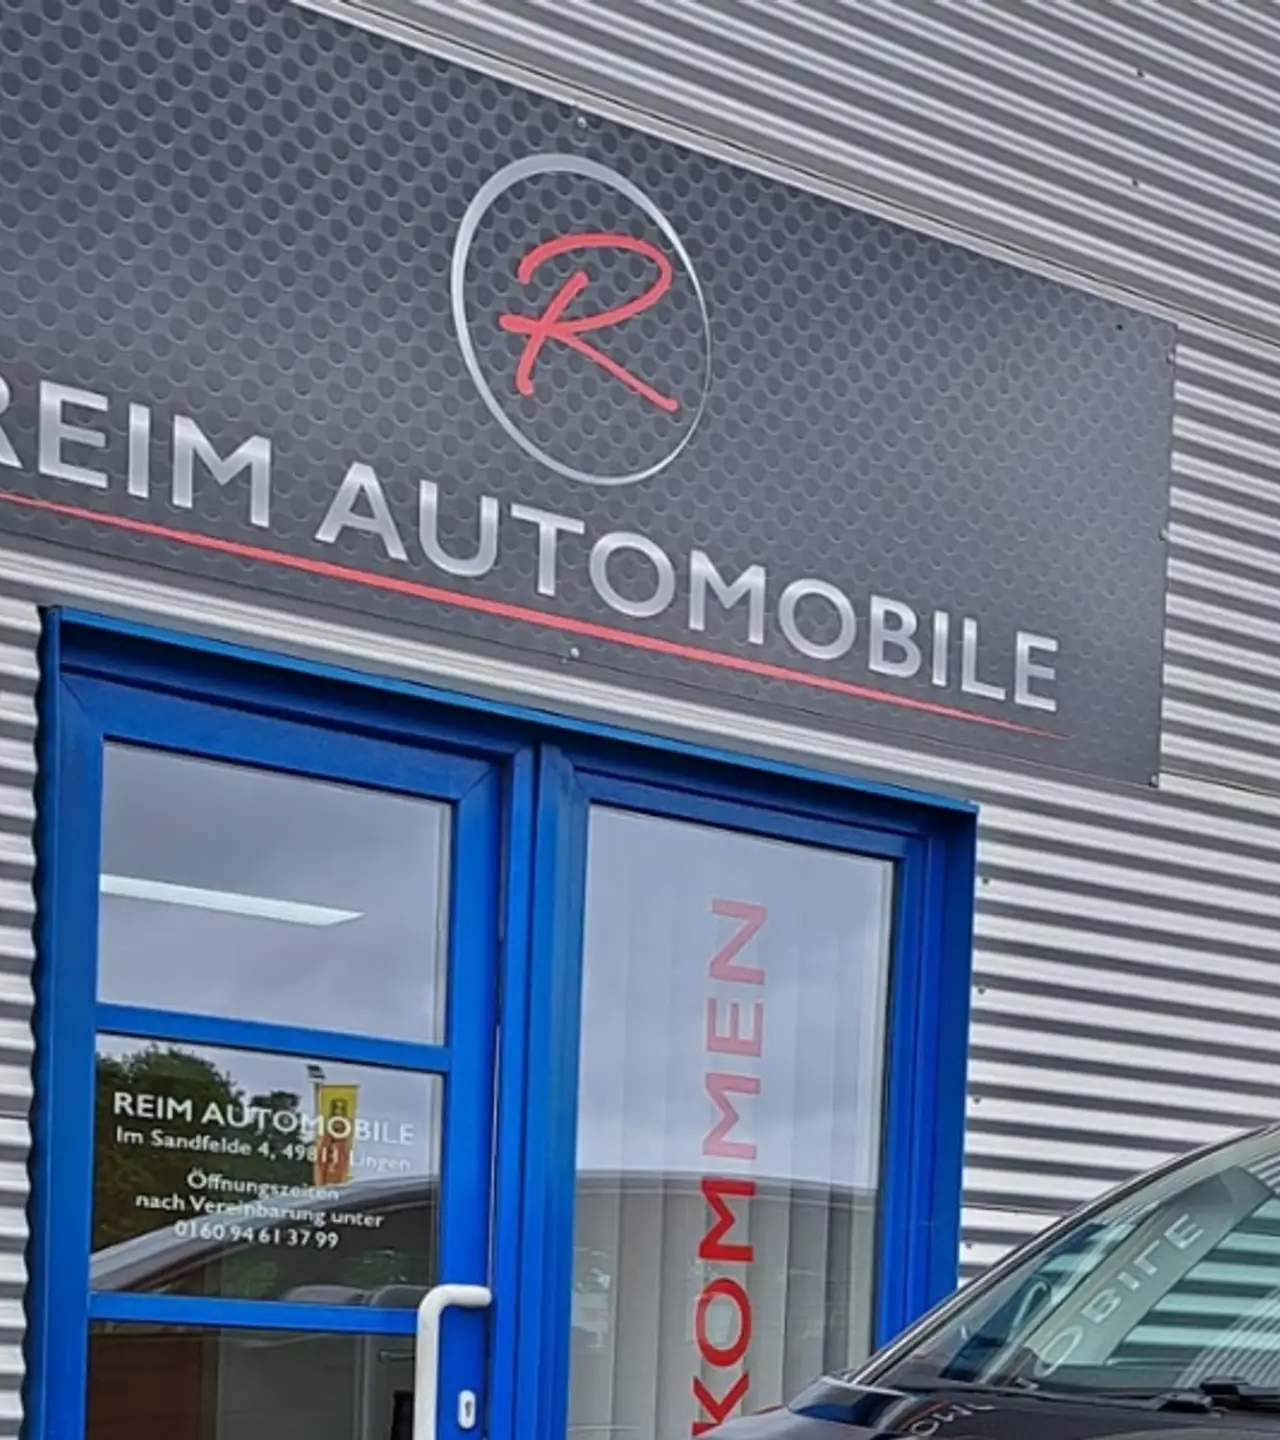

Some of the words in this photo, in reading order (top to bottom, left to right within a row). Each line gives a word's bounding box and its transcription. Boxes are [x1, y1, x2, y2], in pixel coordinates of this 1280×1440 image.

[315, 461, 1060, 714] AUTOMOBILE
[114, 1091, 193, 1123] REIM
[200, 1101, 415, 1147] AUTOMOBILE
[116, 1125, 144, 1145] Im
[150, 1128, 253, 1156] Sandfelde
[257, 1141, 277, 1161] 4,
[348, 1149, 411, 1173] Lingen
[186, 1167, 340, 1201] Öffnungszeiten
[135, 1193, 185, 1211] nach
[189, 1194, 328, 1227] Vereinbarung
[331, 1211, 385, 1228] unter
[174, 1220, 226, 1240] 0160
[230, 1225, 254, 1243] 94
[258, 1227, 280, 1245] 61
[287, 1228, 311, 1247] 37
[315, 1231, 340, 1249] 99
